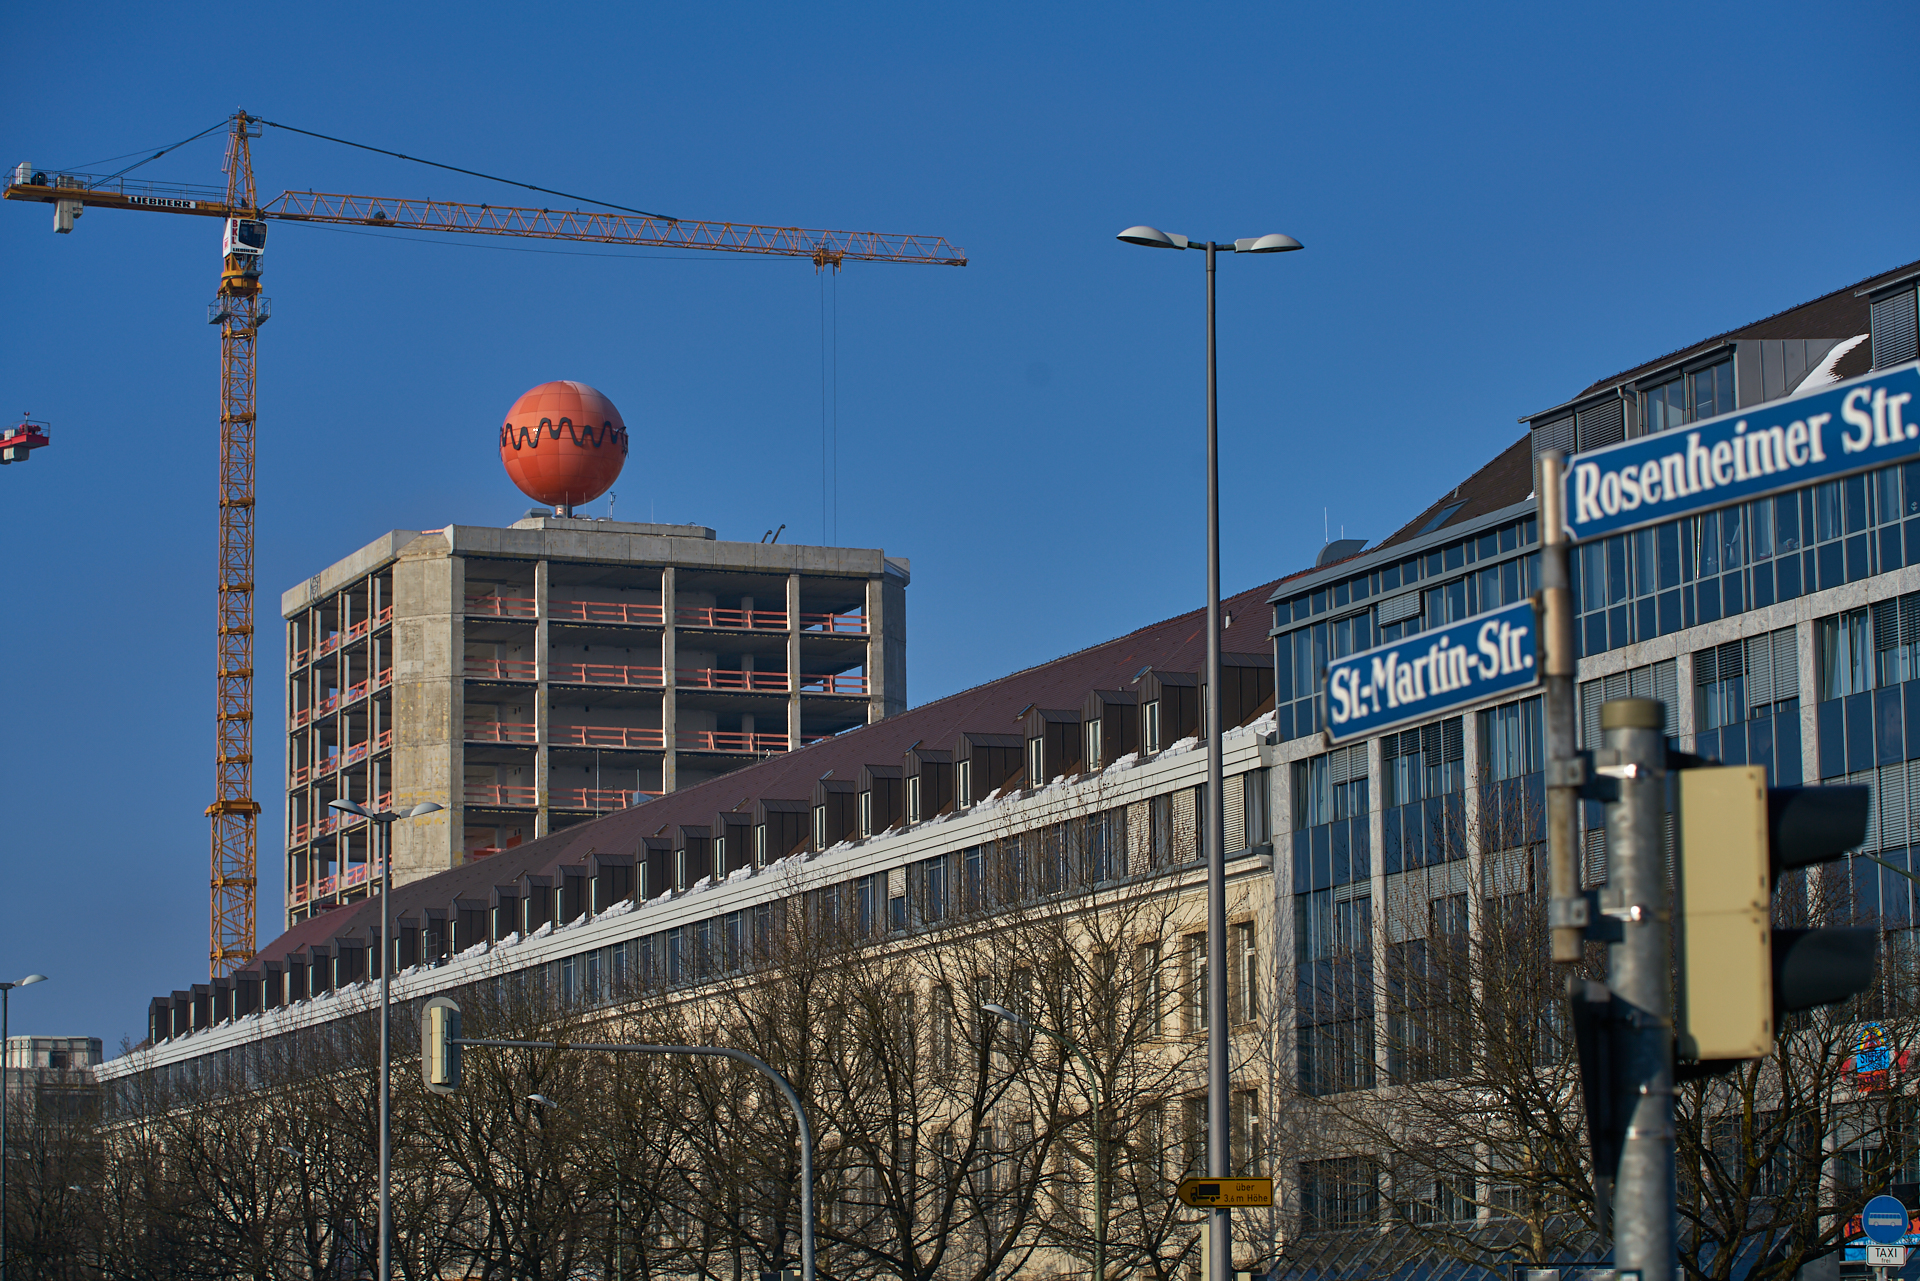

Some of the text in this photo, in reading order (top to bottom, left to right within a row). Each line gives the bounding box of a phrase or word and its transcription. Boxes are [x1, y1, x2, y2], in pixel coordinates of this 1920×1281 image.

[131, 196, 191, 208] LIEBHERR
[1574, 385, 1920, 524] Rosenheimer Str.
[1330, 619, 1534, 725] St.-Martin-Str.
[1236, 1183, 1255, 1191] über
[1247, 1194, 1268, 1202] Höhe
[1874, 1247, 1897, 1258] TAXI
